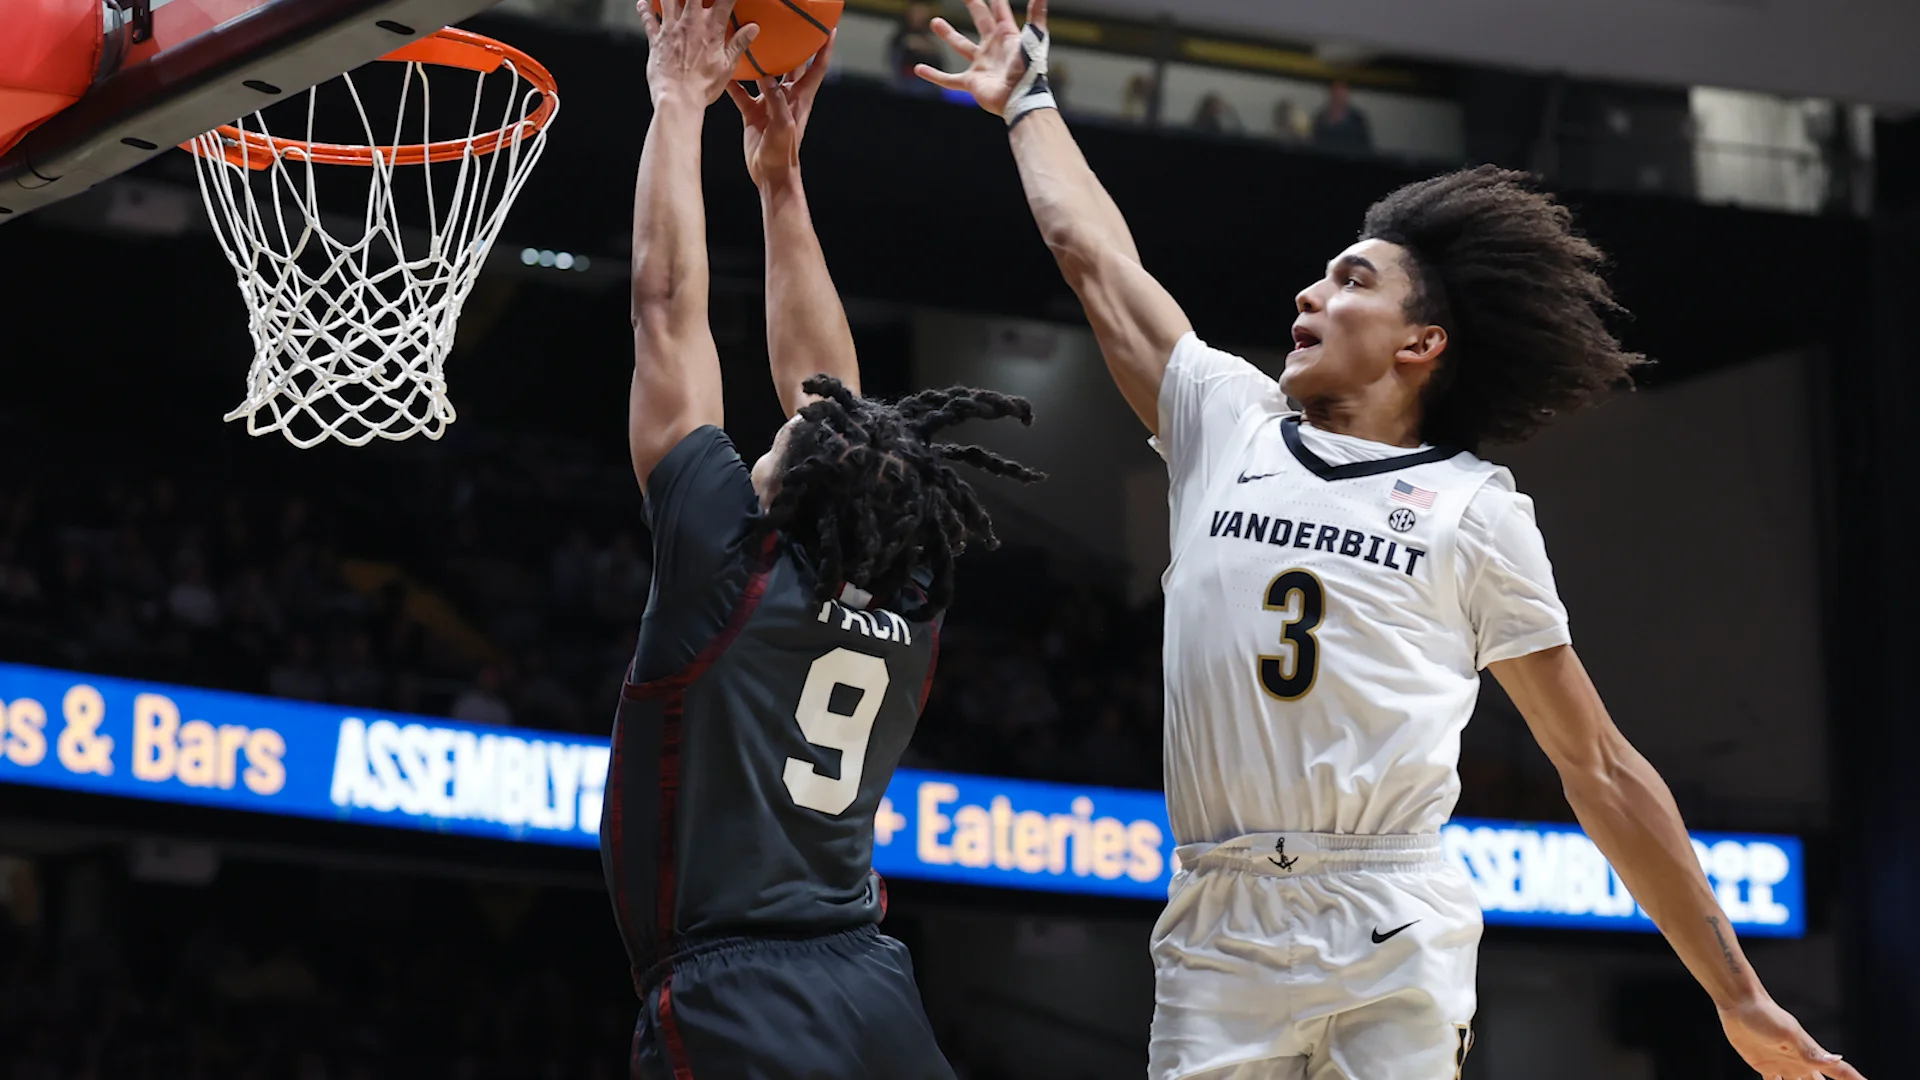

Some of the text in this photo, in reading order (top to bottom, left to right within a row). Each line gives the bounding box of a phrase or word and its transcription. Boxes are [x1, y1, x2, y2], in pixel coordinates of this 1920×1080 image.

[1209, 510, 1426, 577] VANDERBILT
[1389, 508, 1416, 532] SEC
[1257, 567, 1326, 702] 3
[0, 684, 287, 796] s & Bars
[330, 717, 581, 832] ASSEMBLY
[782, 646, 891, 817] 9
[917, 781, 1164, 882] Eateries
[1442, 824, 1651, 919] SSEMBL
